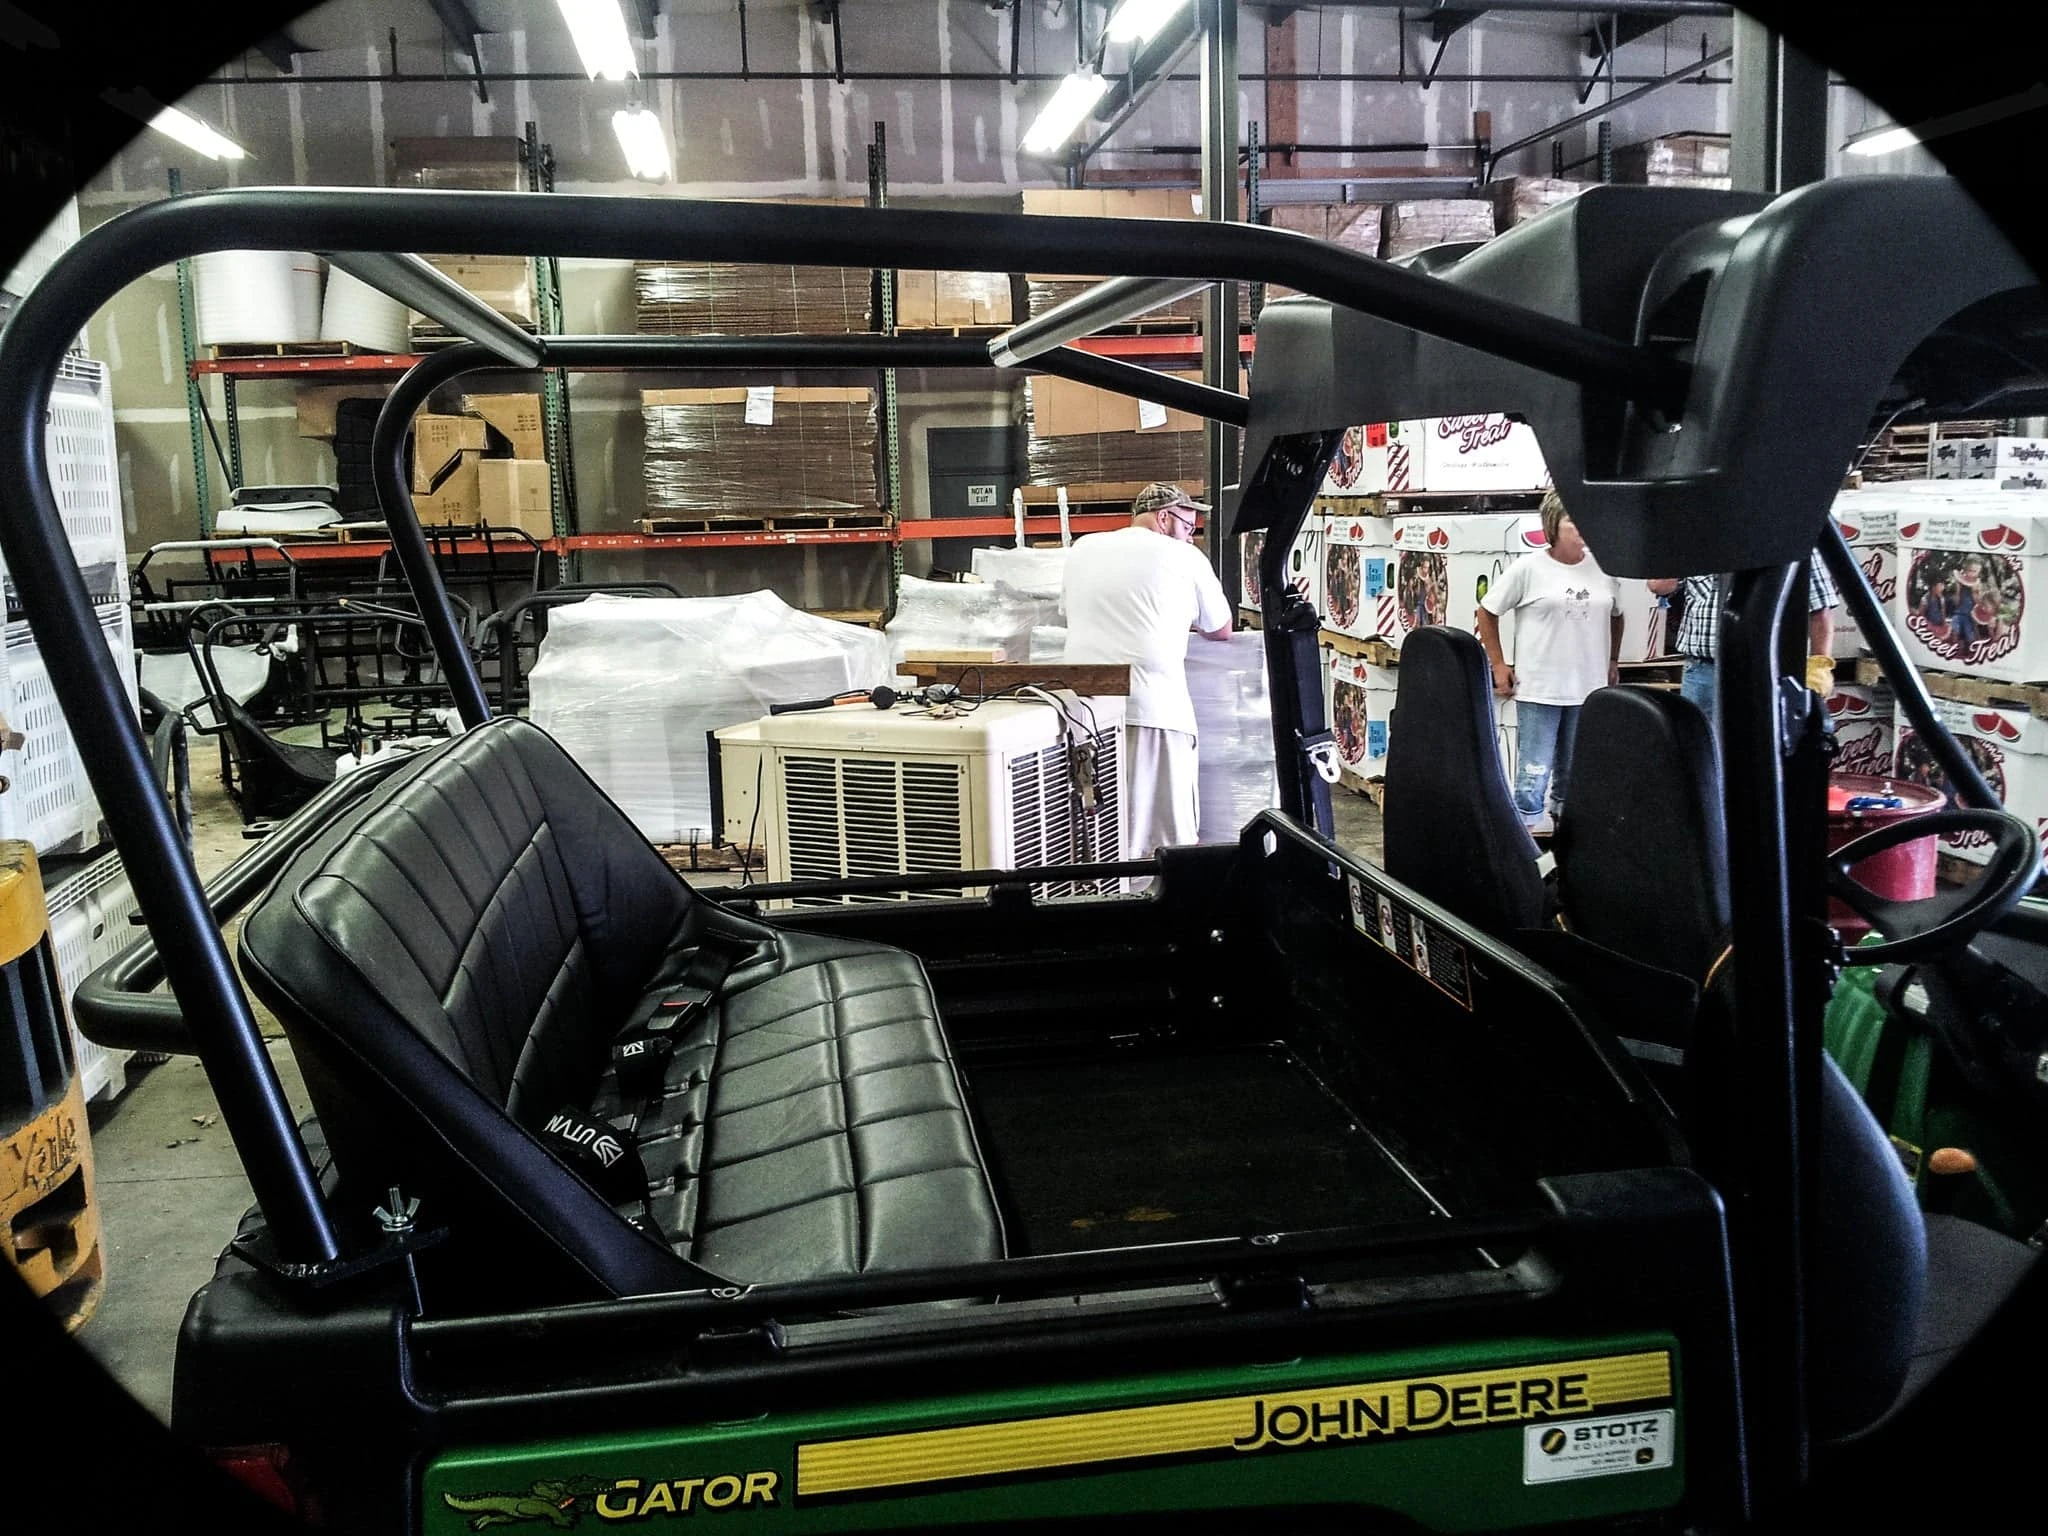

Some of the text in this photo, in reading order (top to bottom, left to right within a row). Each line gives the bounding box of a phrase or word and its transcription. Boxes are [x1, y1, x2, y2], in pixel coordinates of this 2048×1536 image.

[1459, 418, 1512, 454] Treat
[971, 487, 984, 495] NOT
[976, 495, 988, 503] EXIT
[1906, 614, 2020, 665] Sweet Treat
[1849, 751, 1891, 776] Trea
[1234, 1373, 1589, 1447] JOHN DEERE
[1572, 1434, 1658, 1451] EQUIPMENT
[1573, 1418, 1659, 1442] STOTZ
[596, 1471, 777, 1519] GATOR
